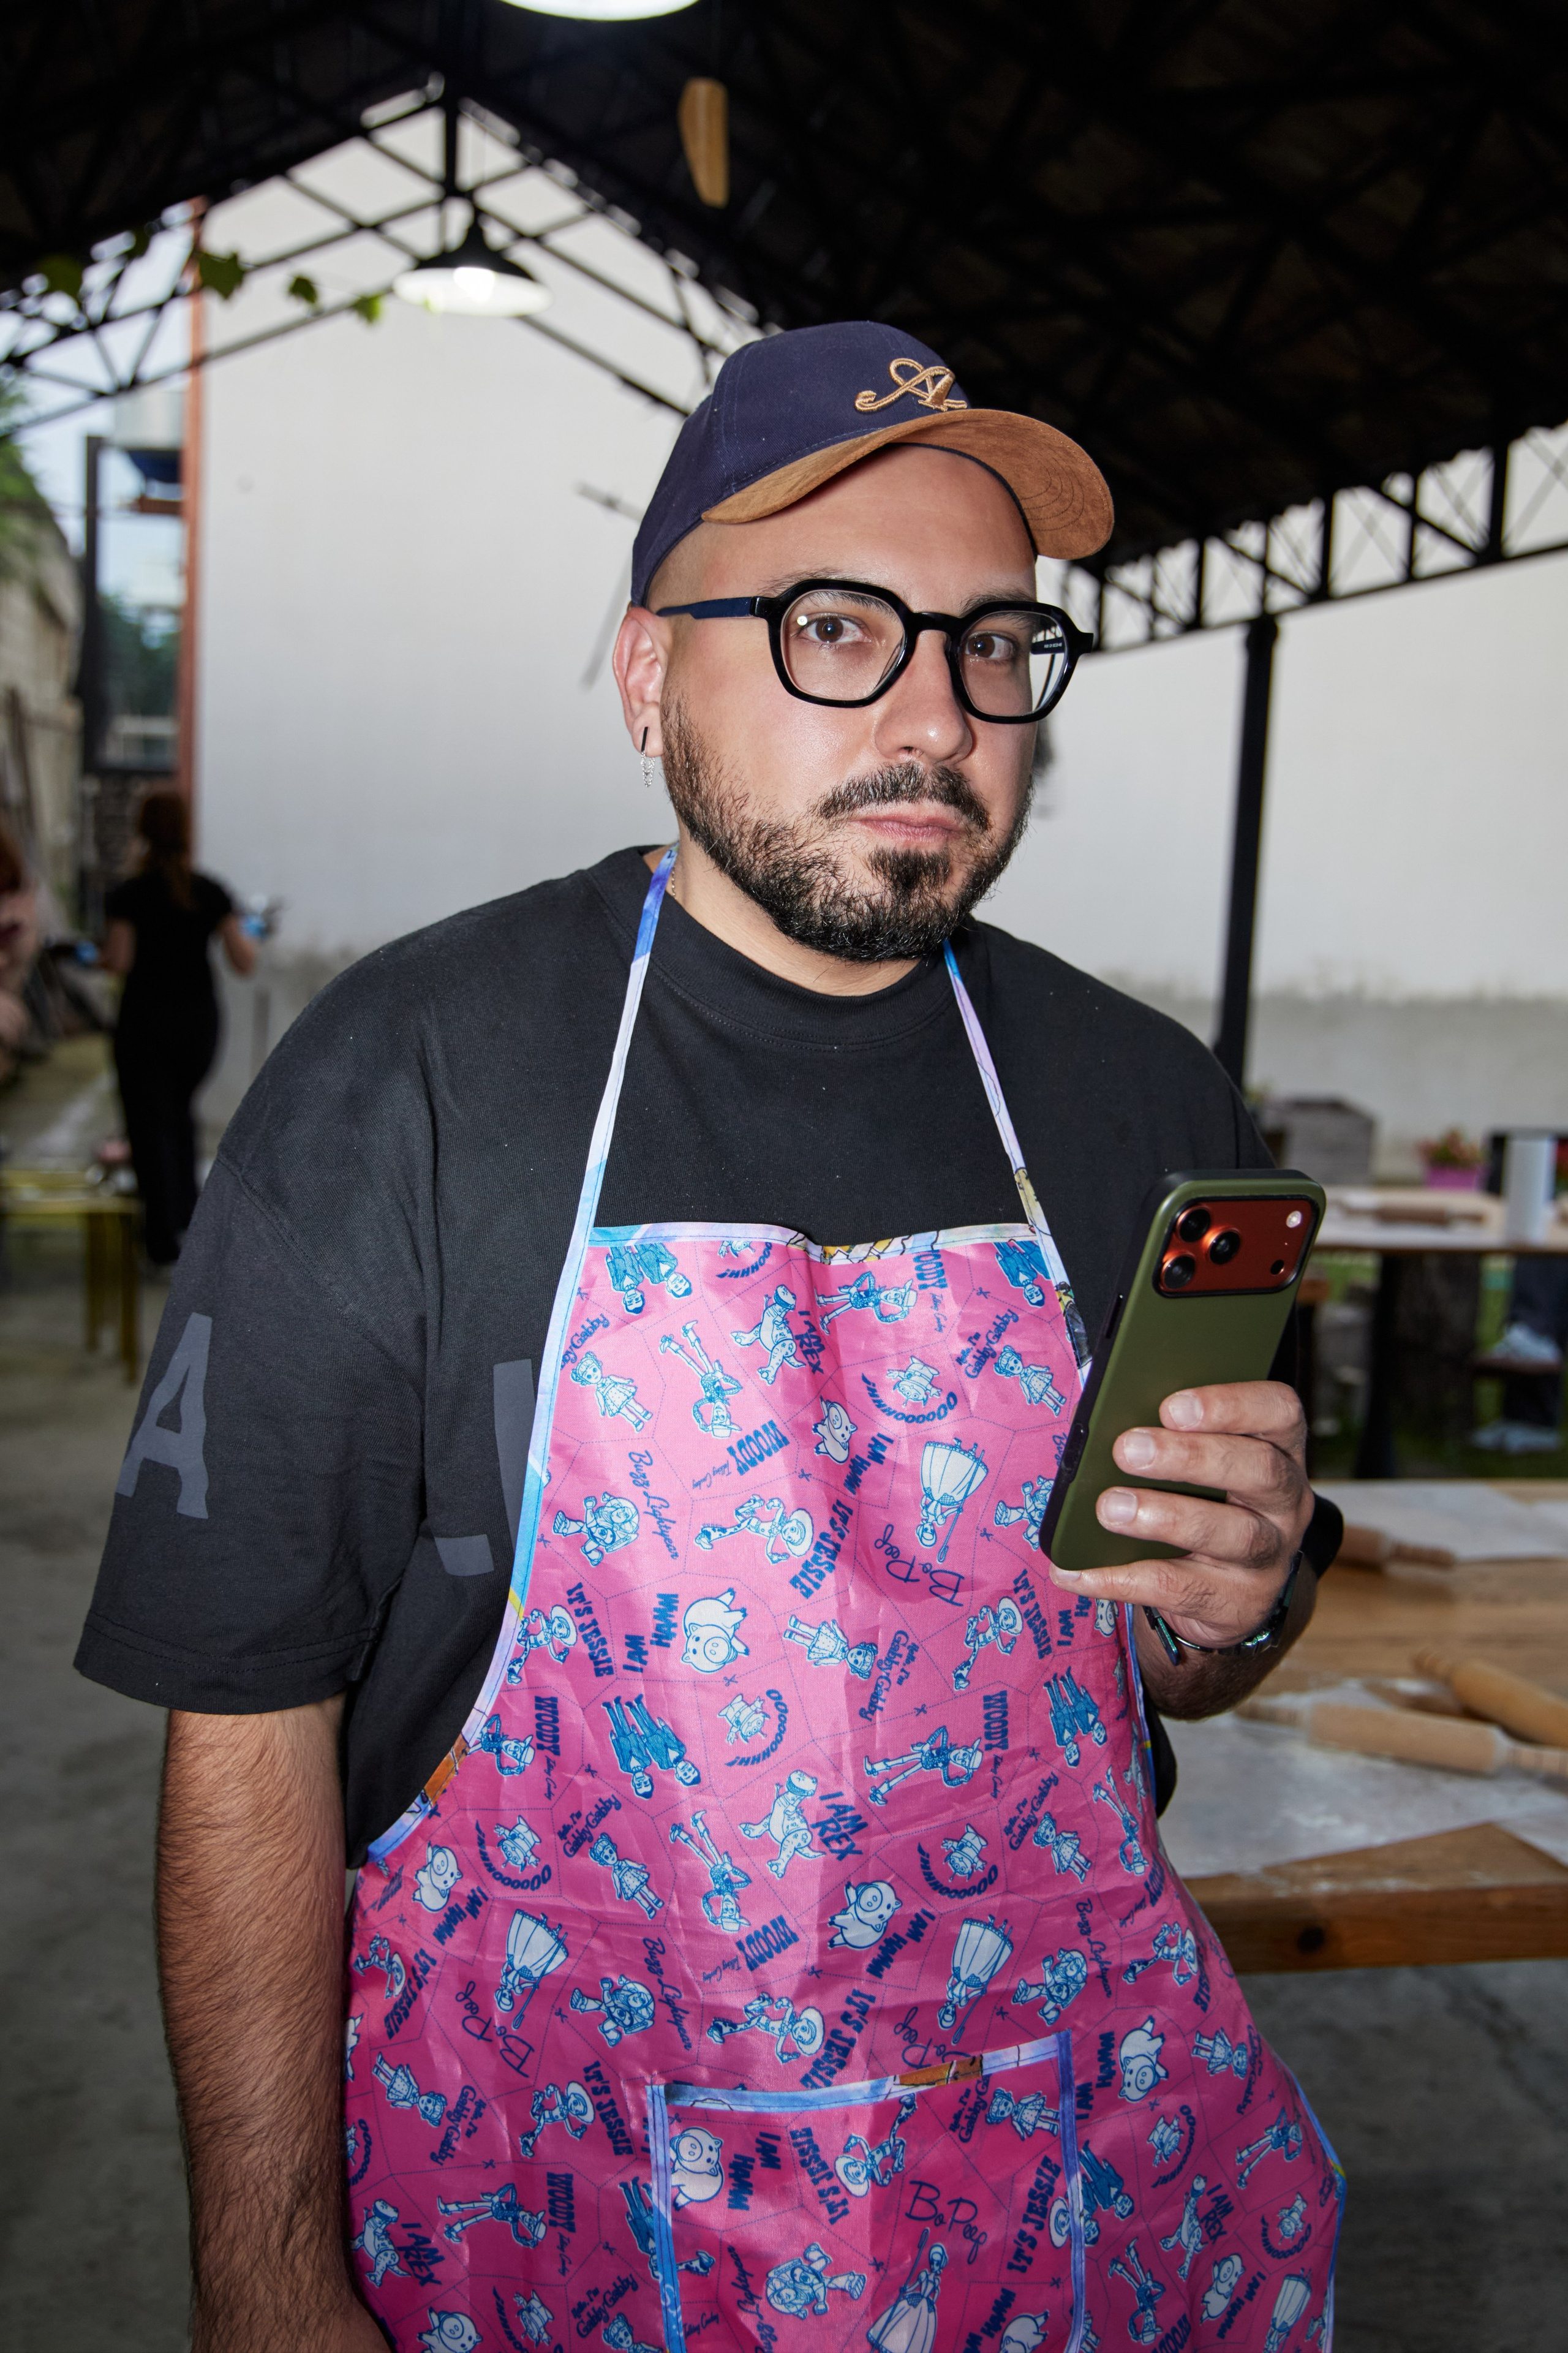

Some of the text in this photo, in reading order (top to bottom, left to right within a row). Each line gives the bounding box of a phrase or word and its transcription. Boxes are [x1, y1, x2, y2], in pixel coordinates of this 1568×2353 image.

[913, 1249, 948, 1290] OODY
[794, 1333, 825, 1375] REX
[804, 1320, 826, 1353] AM
[115, 1312, 213, 1519] A
[877, 1432, 894, 1445] I
[726, 1419, 790, 1476] WOODY
[789, 1498, 854, 1600] IT'S JESSIE
[874, 1524, 965, 1607] Bo Peep
[566, 1581, 614, 1678] IT'S JESSIE
[1012, 1568, 1053, 1660] IT'S JESSIE
[1058, 1609, 1075, 1638] AM
[1074, 1595, 1093, 1617] HA
[622, 1634, 649, 1674] I AM
[534, 1696, 561, 1756] WOODY
[983, 1690, 1009, 1751] WOODY
[810, 1816, 864, 1862] REX
[818, 1791, 869, 1836] I AM
[735, 1914, 801, 1973] WOODY
[921, 1908, 937, 1922] I
[455, 1981, 535, 2079] Bo Peep
[840, 1989, 877, 2034] IT'S
[894, 2006, 933, 2070] Peep
[582, 2060, 635, 2156] IT'S JESSIE
[755, 2131, 782, 2170] I AM
[789, 2126, 850, 2226] IT'S JESSIE
[547, 2170, 576, 2234] WOODY
[905, 2180, 988, 2265] Bo Peep
[1006, 2154, 1062, 2274] IT'S JESSIE
[395, 2244, 443, 2287] REX
[407, 2232, 446, 2266] AM
